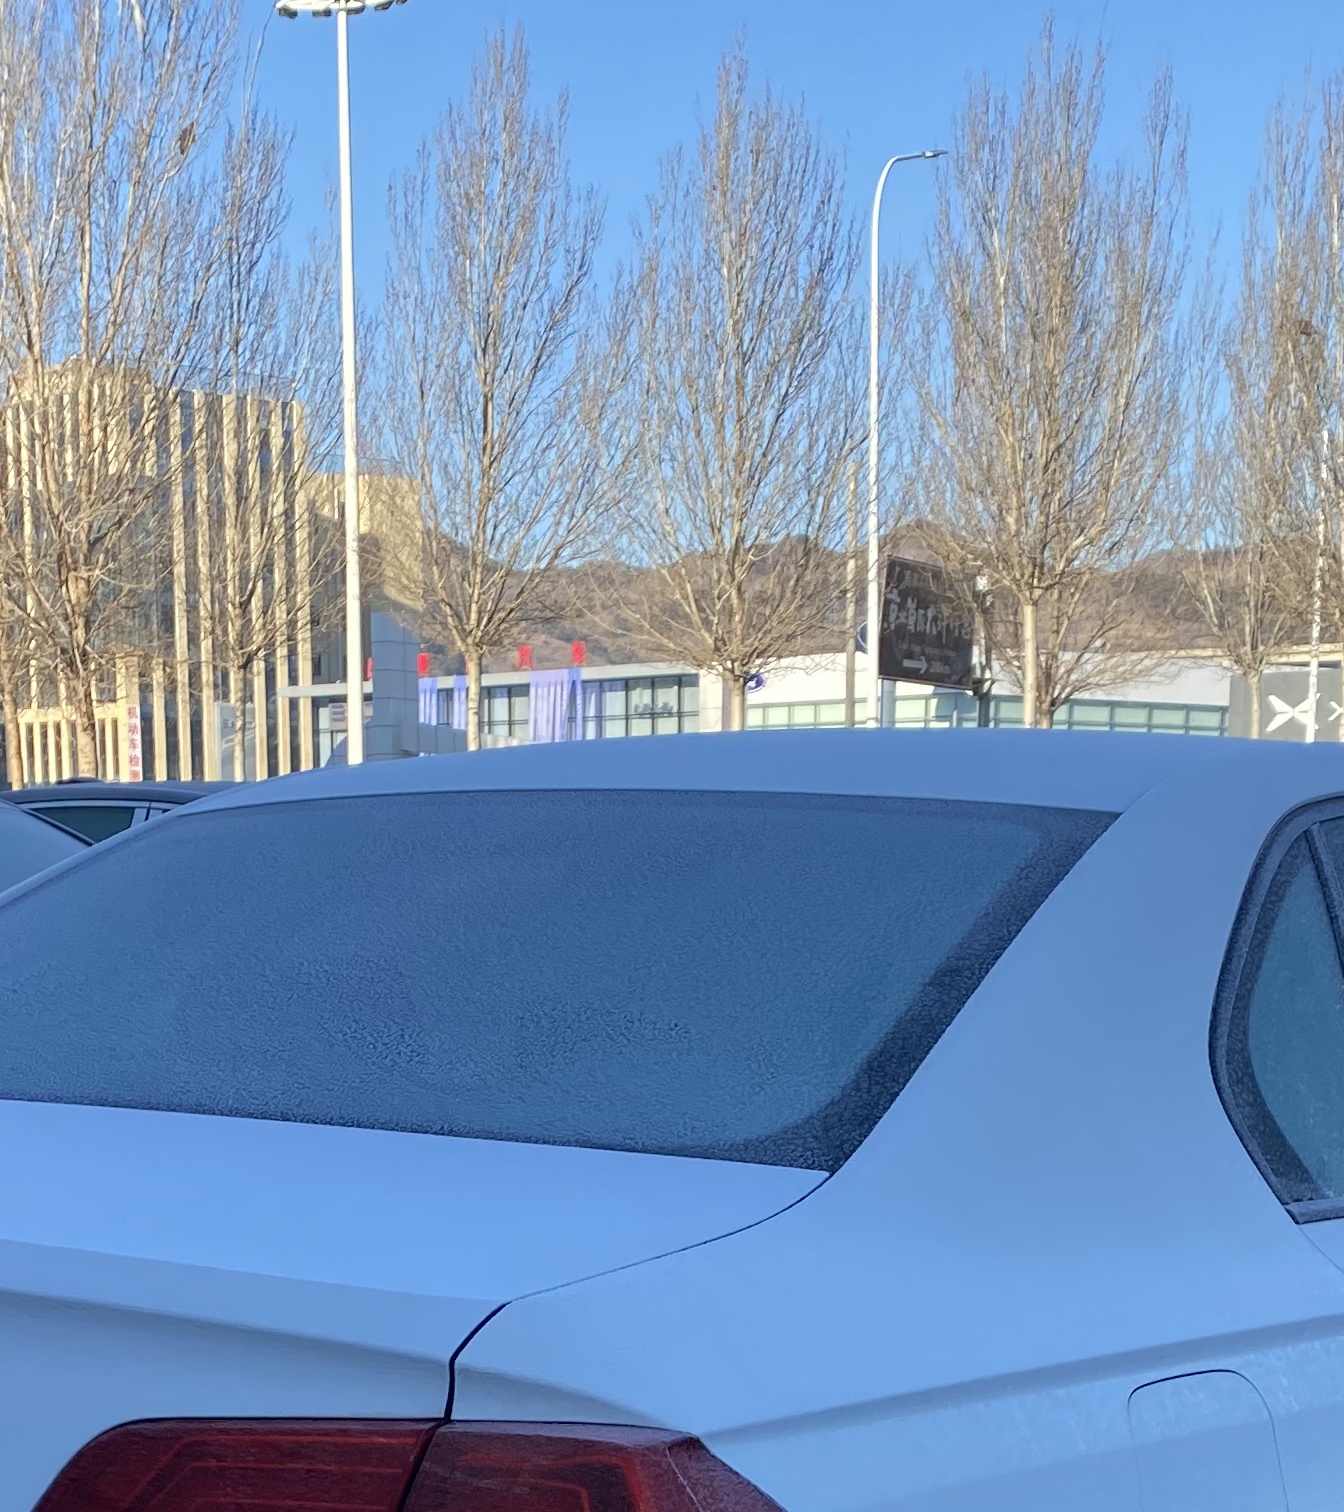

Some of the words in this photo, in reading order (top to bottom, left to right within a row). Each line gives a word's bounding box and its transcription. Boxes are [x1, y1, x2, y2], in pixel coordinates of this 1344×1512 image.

[128, 706, 141, 782] 机动车检测
